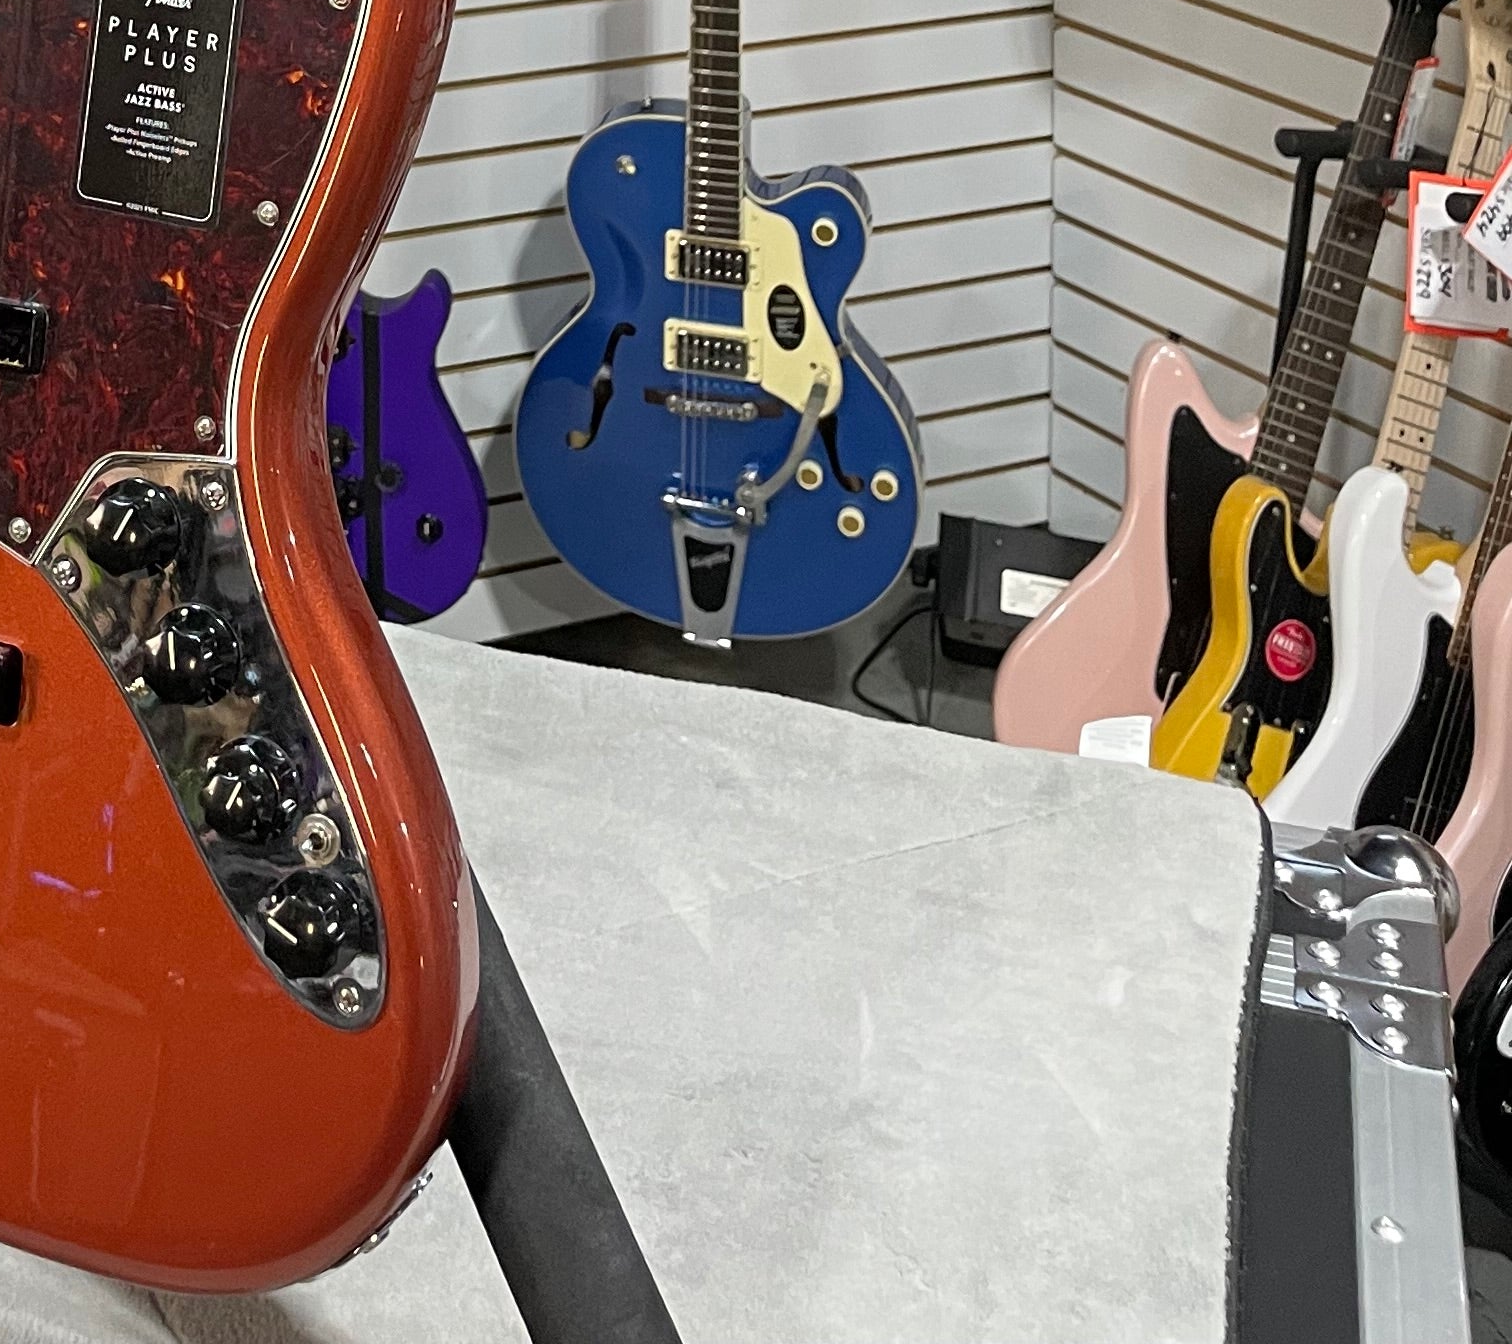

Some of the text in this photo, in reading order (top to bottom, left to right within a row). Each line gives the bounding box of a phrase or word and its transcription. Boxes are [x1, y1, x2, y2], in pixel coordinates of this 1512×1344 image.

[108, 15, 219, 52] PLAYER
[124, 44, 196, 73] PLUS
[124, 93, 152, 108] JAZZ
[137, 82, 176, 99] ACTIVE
